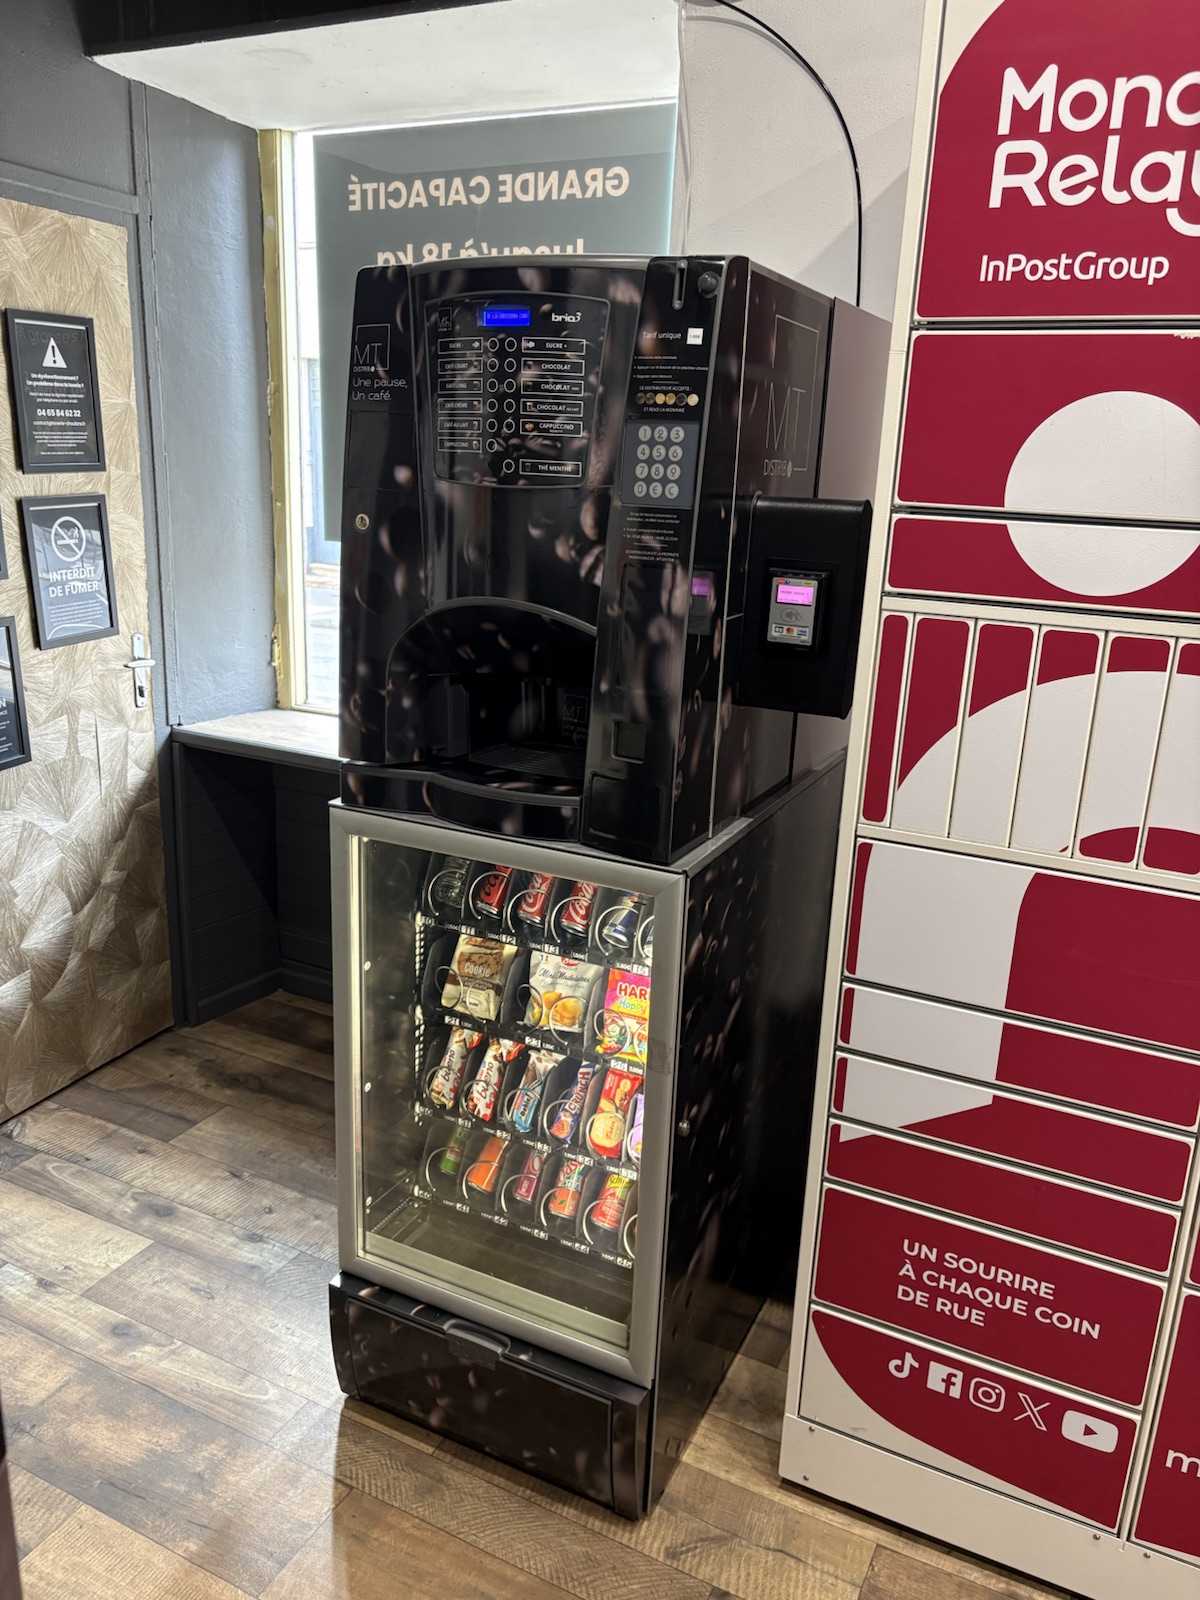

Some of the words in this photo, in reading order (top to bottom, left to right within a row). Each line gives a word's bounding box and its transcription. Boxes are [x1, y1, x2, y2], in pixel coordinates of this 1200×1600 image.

[979, 251, 1170, 285] InPostGroup
[642, 331, 657, 339] Tarif
[658, 332, 682, 340] unique
[353, 343, 382, 364] MT
[352, 378, 371, 388] Une
[374, 378, 408, 389] pause,
[352, 391, 366, 400] Un
[36, 408, 46, 416] 04
[765, 382, 806, 450] MT
[657, 430, 664, 439] 2
[674, 430, 681, 439] 3
[640, 448, 646, 456] 4
[656, 448, 662, 458] 5
[672, 448, 679, 458] 6
[549, 464, 572, 472] MENTHE
[639, 466, 645, 475] 7
[654, 466, 660, 476] 8
[670, 468, 677, 477] 9
[49, 566, 95, 582] INTERDIT
[48, 586, 64, 598] DE
[64, 581, 99, 596] FUMER
[464, 962, 491, 978] Cookie
[618, 983, 648, 1001] HAR
[619, 998, 646, 1015] Happy
[441, 1050, 455, 1082] bueno
[476, 1062, 494, 1100] bueno
[568, 1071, 590, 1112] CRUNCH
[902, 1238, 938, 1264] UN
[943, 1251, 1056, 1300] SOURIRE
[896, 1284, 930, 1309] DE
[936, 1298, 986, 1327] RUE
[898, 1258, 917, 1280] À
[921, 1270, 1029, 1317] CHAQUE
[1034, 1305, 1101, 1340] COIN
